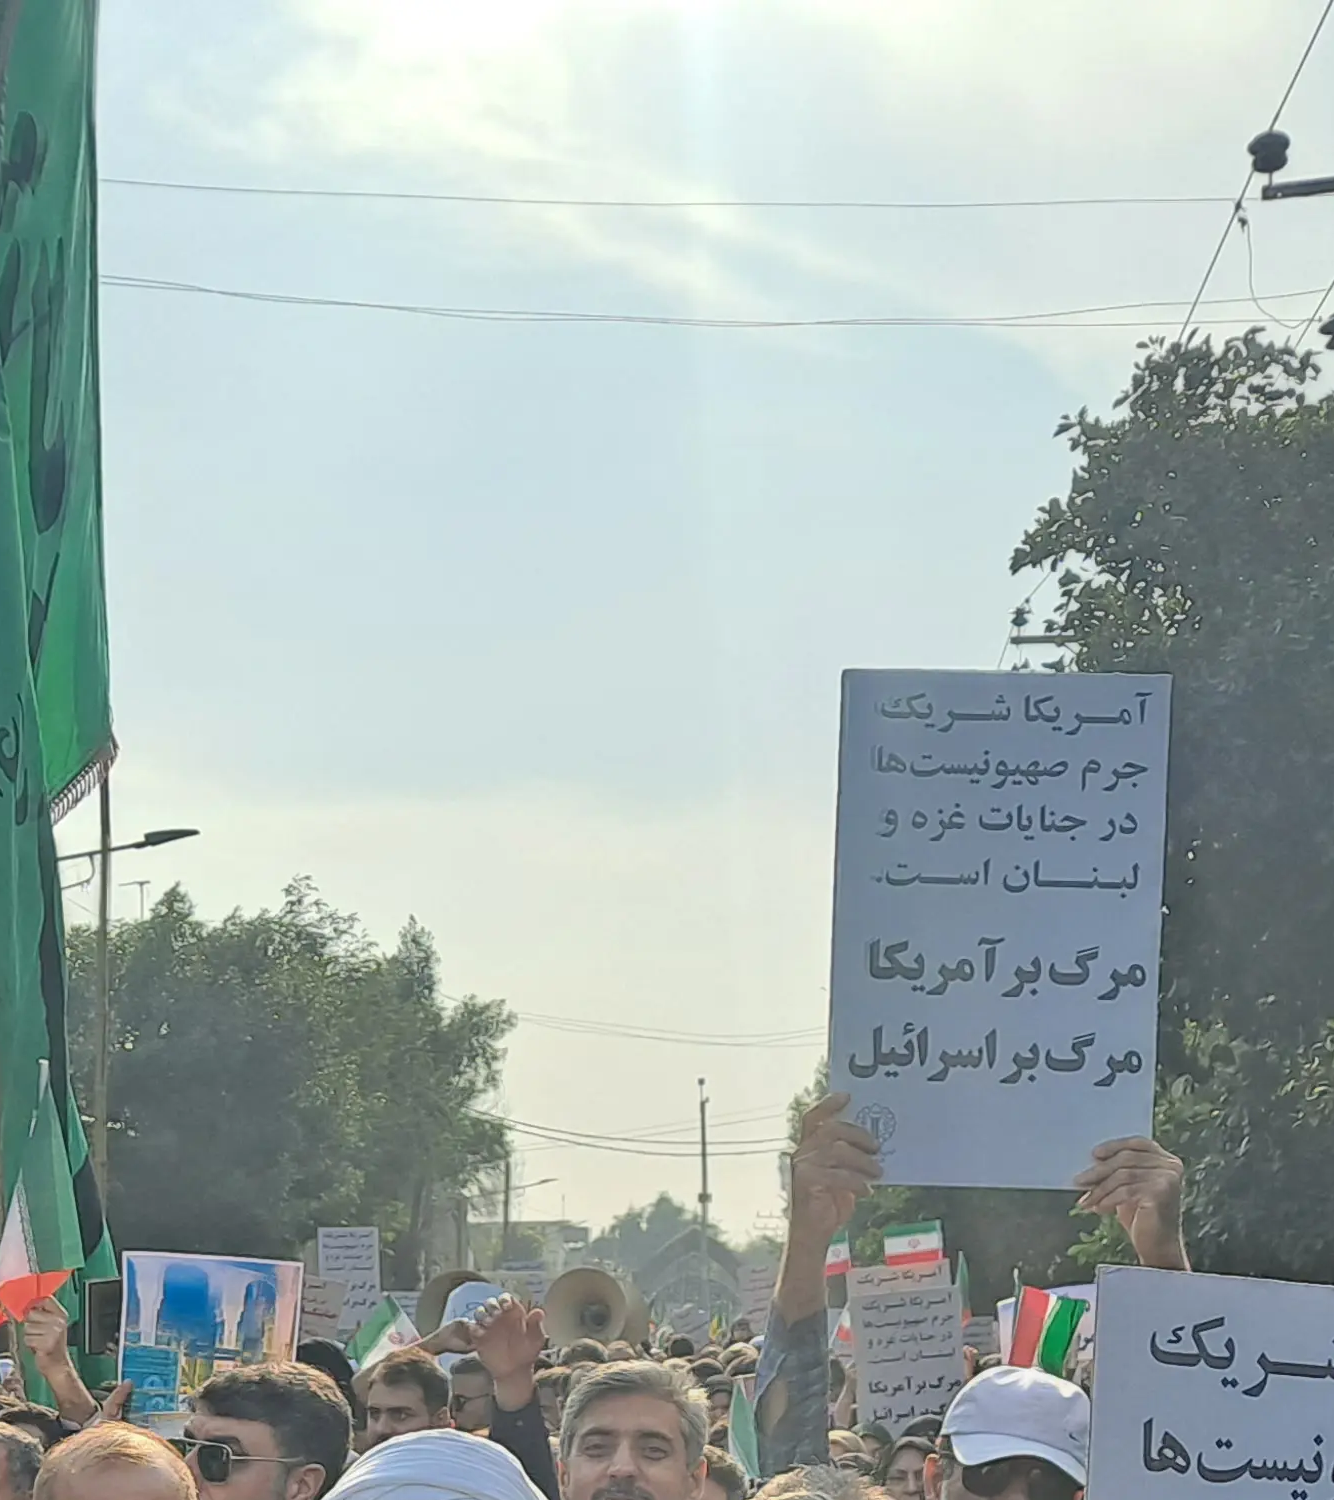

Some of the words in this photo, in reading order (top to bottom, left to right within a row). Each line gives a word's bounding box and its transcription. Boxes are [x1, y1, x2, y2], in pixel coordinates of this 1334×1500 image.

[876, 693, 1011, 733] شریک
[1024, 692, 1153, 735] آمریکا
[1080, 755, 1149, 791] جرم
[879, 807, 900, 838] و
[912, 803, 966, 841] غزه
[978, 803, 1087, 841] جنایات
[1098, 811, 1138, 841] در
[1003, 861, 1139, 898] لبنان
[868, 936, 1006, 996] آمریکا
[1001, 956, 1042, 998] بر
[1049, 945, 1147, 1000] مرگ
[848, 1022, 997, 1082] اسرائیل
[999, 1043, 1040, 1084] بر
[1045, 1032, 1143, 1087] مرگ
